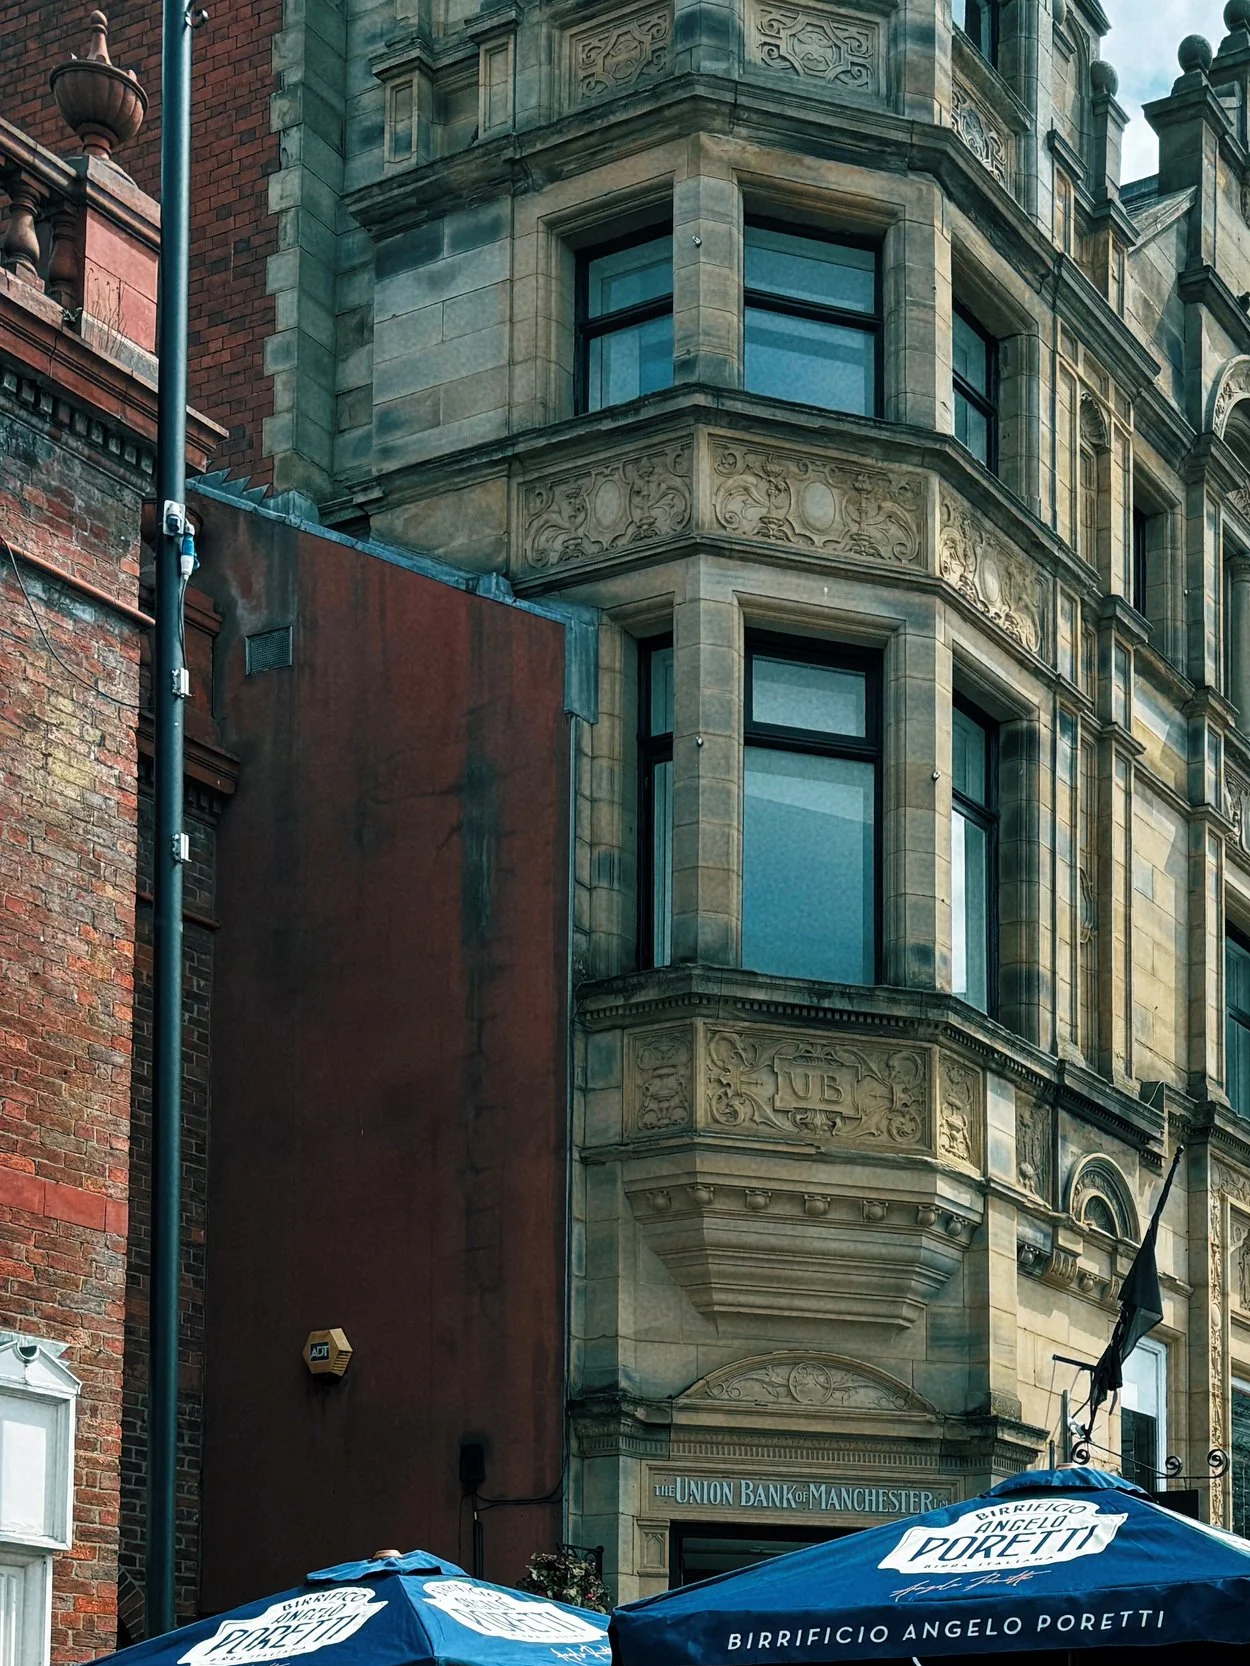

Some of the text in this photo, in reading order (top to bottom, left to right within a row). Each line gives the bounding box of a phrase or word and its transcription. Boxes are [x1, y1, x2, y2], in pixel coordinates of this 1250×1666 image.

[654, 1477, 933, 1514] THE UNION BANK OF MANCHESTER
[975, 1503, 1087, 1521] BIRRIFICIO
[974, 1515, 1067, 1534] ANGELO
[908, 1525, 1099, 1562] PORETTI
[271, 1603, 347, 1625] ANGELO
[727, 1610, 1165, 1650] BIRRIFICIO ANGELO PORETTI
[203, 1614, 358, 1656] PORETTI
